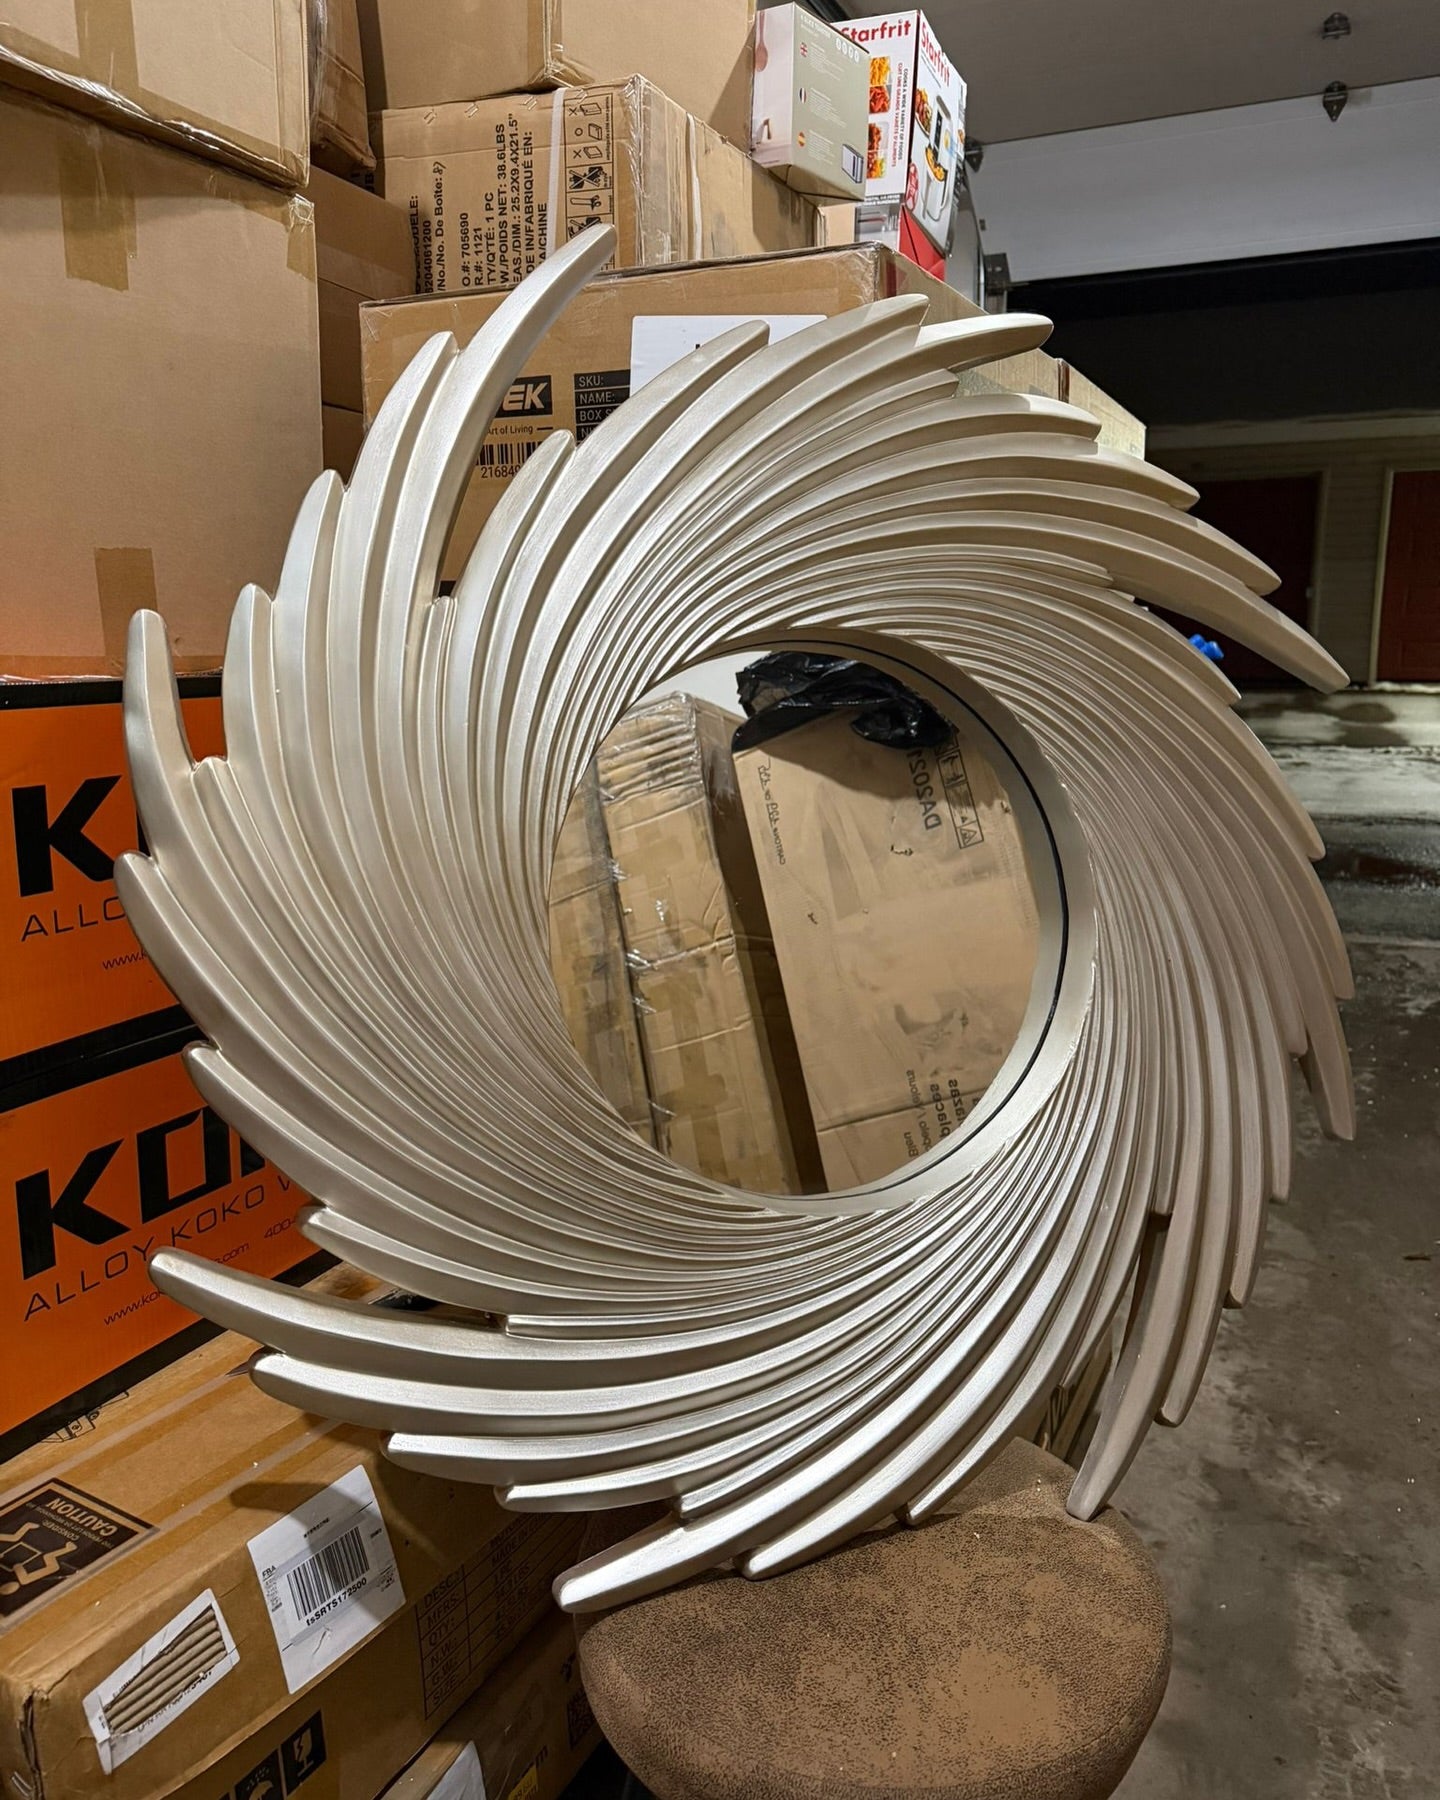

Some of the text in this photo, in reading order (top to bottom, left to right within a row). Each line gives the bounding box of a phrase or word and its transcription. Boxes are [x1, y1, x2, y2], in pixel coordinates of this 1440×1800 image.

[495, 123, 507, 181] 38.6LBS
[523, 131, 533, 153] EN:
[484, 192, 494, 212] PC
[497, 183, 507, 216] NET:
[521, 161, 535, 251] IN/FABRIQUÉ
[435, 220, 444, 237] De
[459, 212, 469, 258] 705690
[473, 226, 482, 256] 1121
[578, 375, 604, 387] SKU:
[579, 392, 615, 405] NAME:
[580, 410, 602, 422] BOX
[500, 426, 508, 435] of
[510, 424, 533, 435] Living
[23, 1184, 265, 1323] ALLOY KOKO
[46, 1498, 118, 1536] CAUTION
